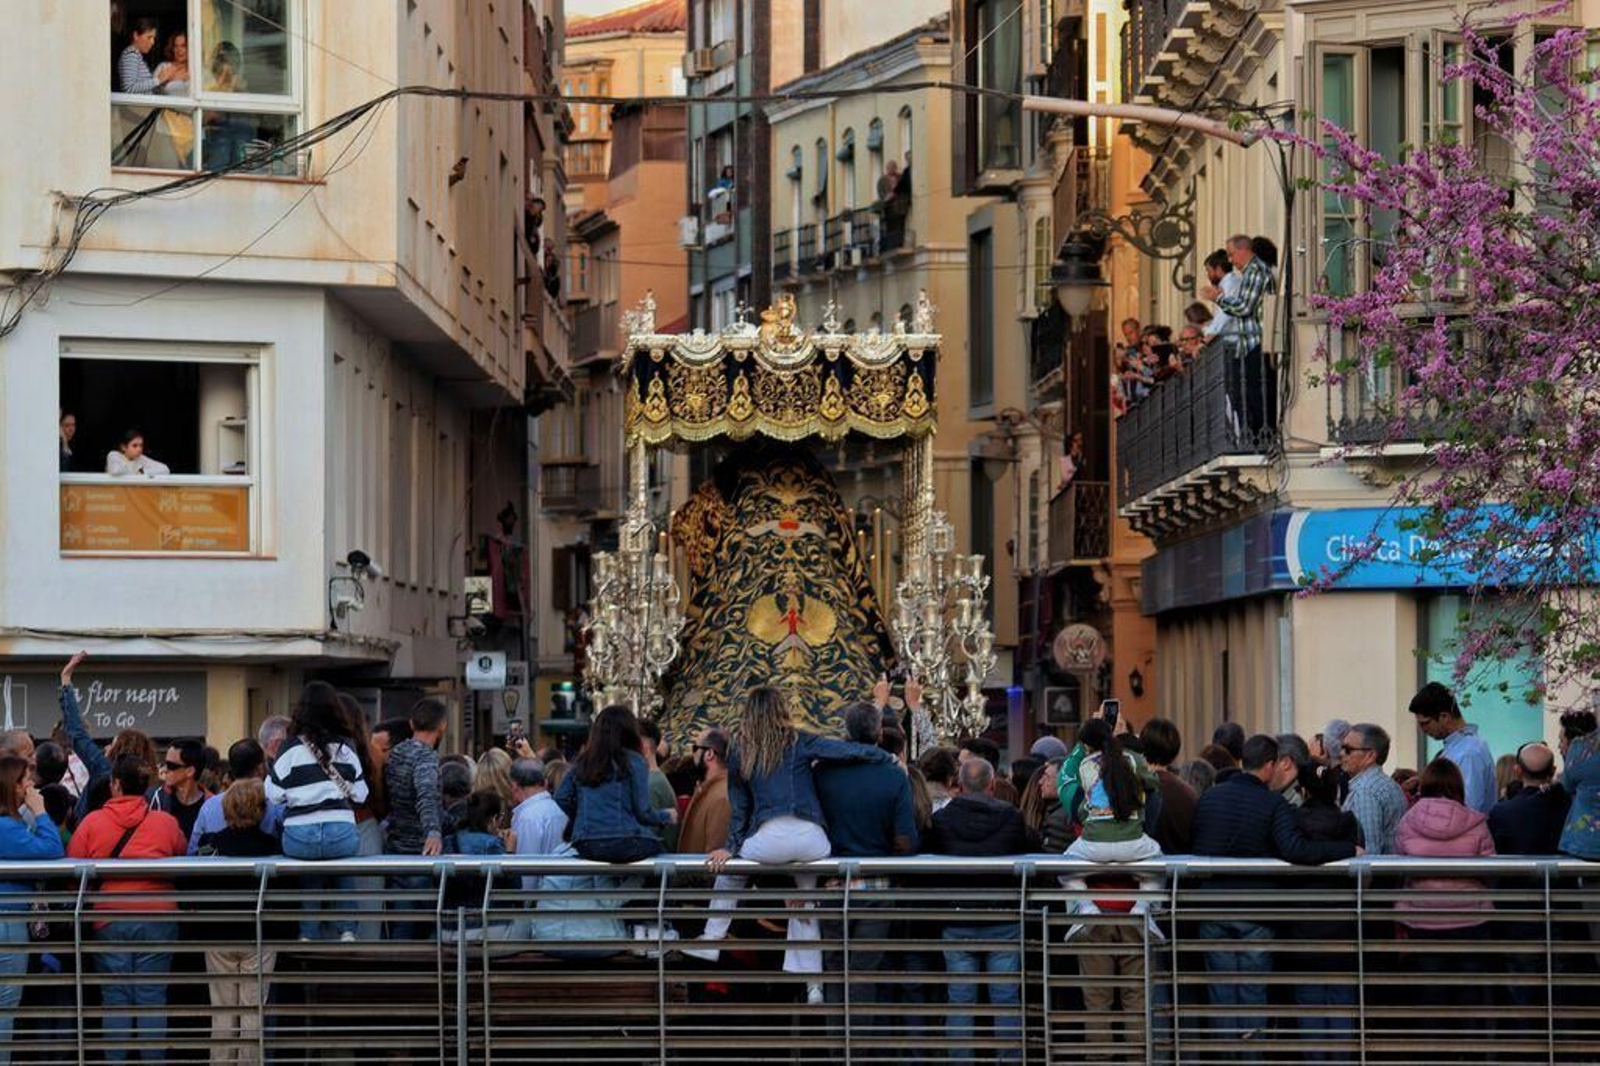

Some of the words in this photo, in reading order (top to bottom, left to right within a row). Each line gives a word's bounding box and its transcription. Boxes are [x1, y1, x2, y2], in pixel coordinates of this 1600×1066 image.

[83, 680, 121, 717] flor
[126, 687, 180, 717] negra
[93, 712, 112, 728] To
[116, 711, 136, 728] Go
